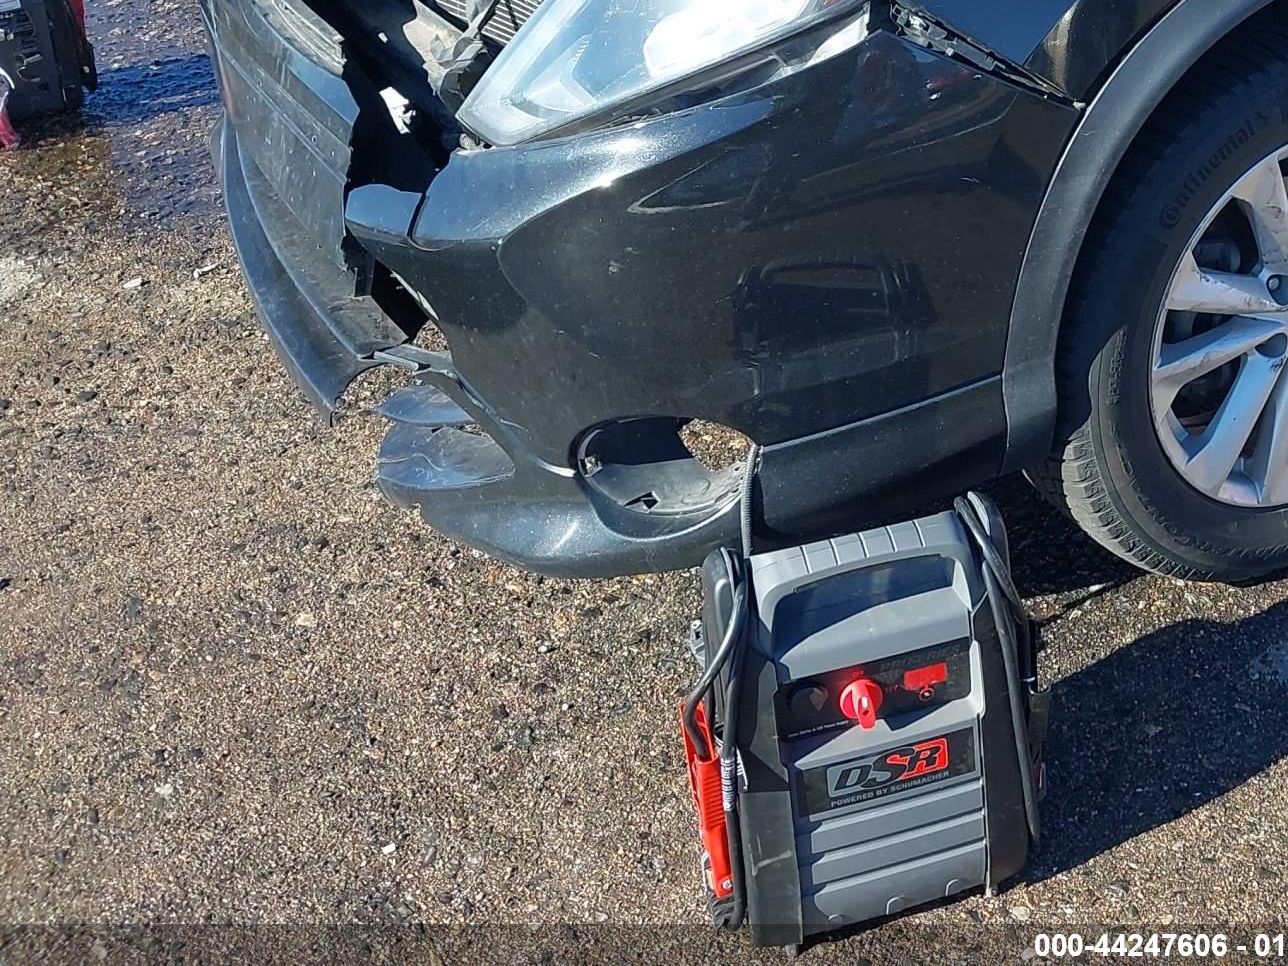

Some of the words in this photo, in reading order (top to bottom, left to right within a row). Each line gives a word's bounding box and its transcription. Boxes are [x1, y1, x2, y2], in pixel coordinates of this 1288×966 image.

[833, 744, 943, 791] DSR
[830, 791, 874, 808] POWERED
[876, 788, 889, 797] BY
[890, 770, 950, 792] SCHUMACHER
